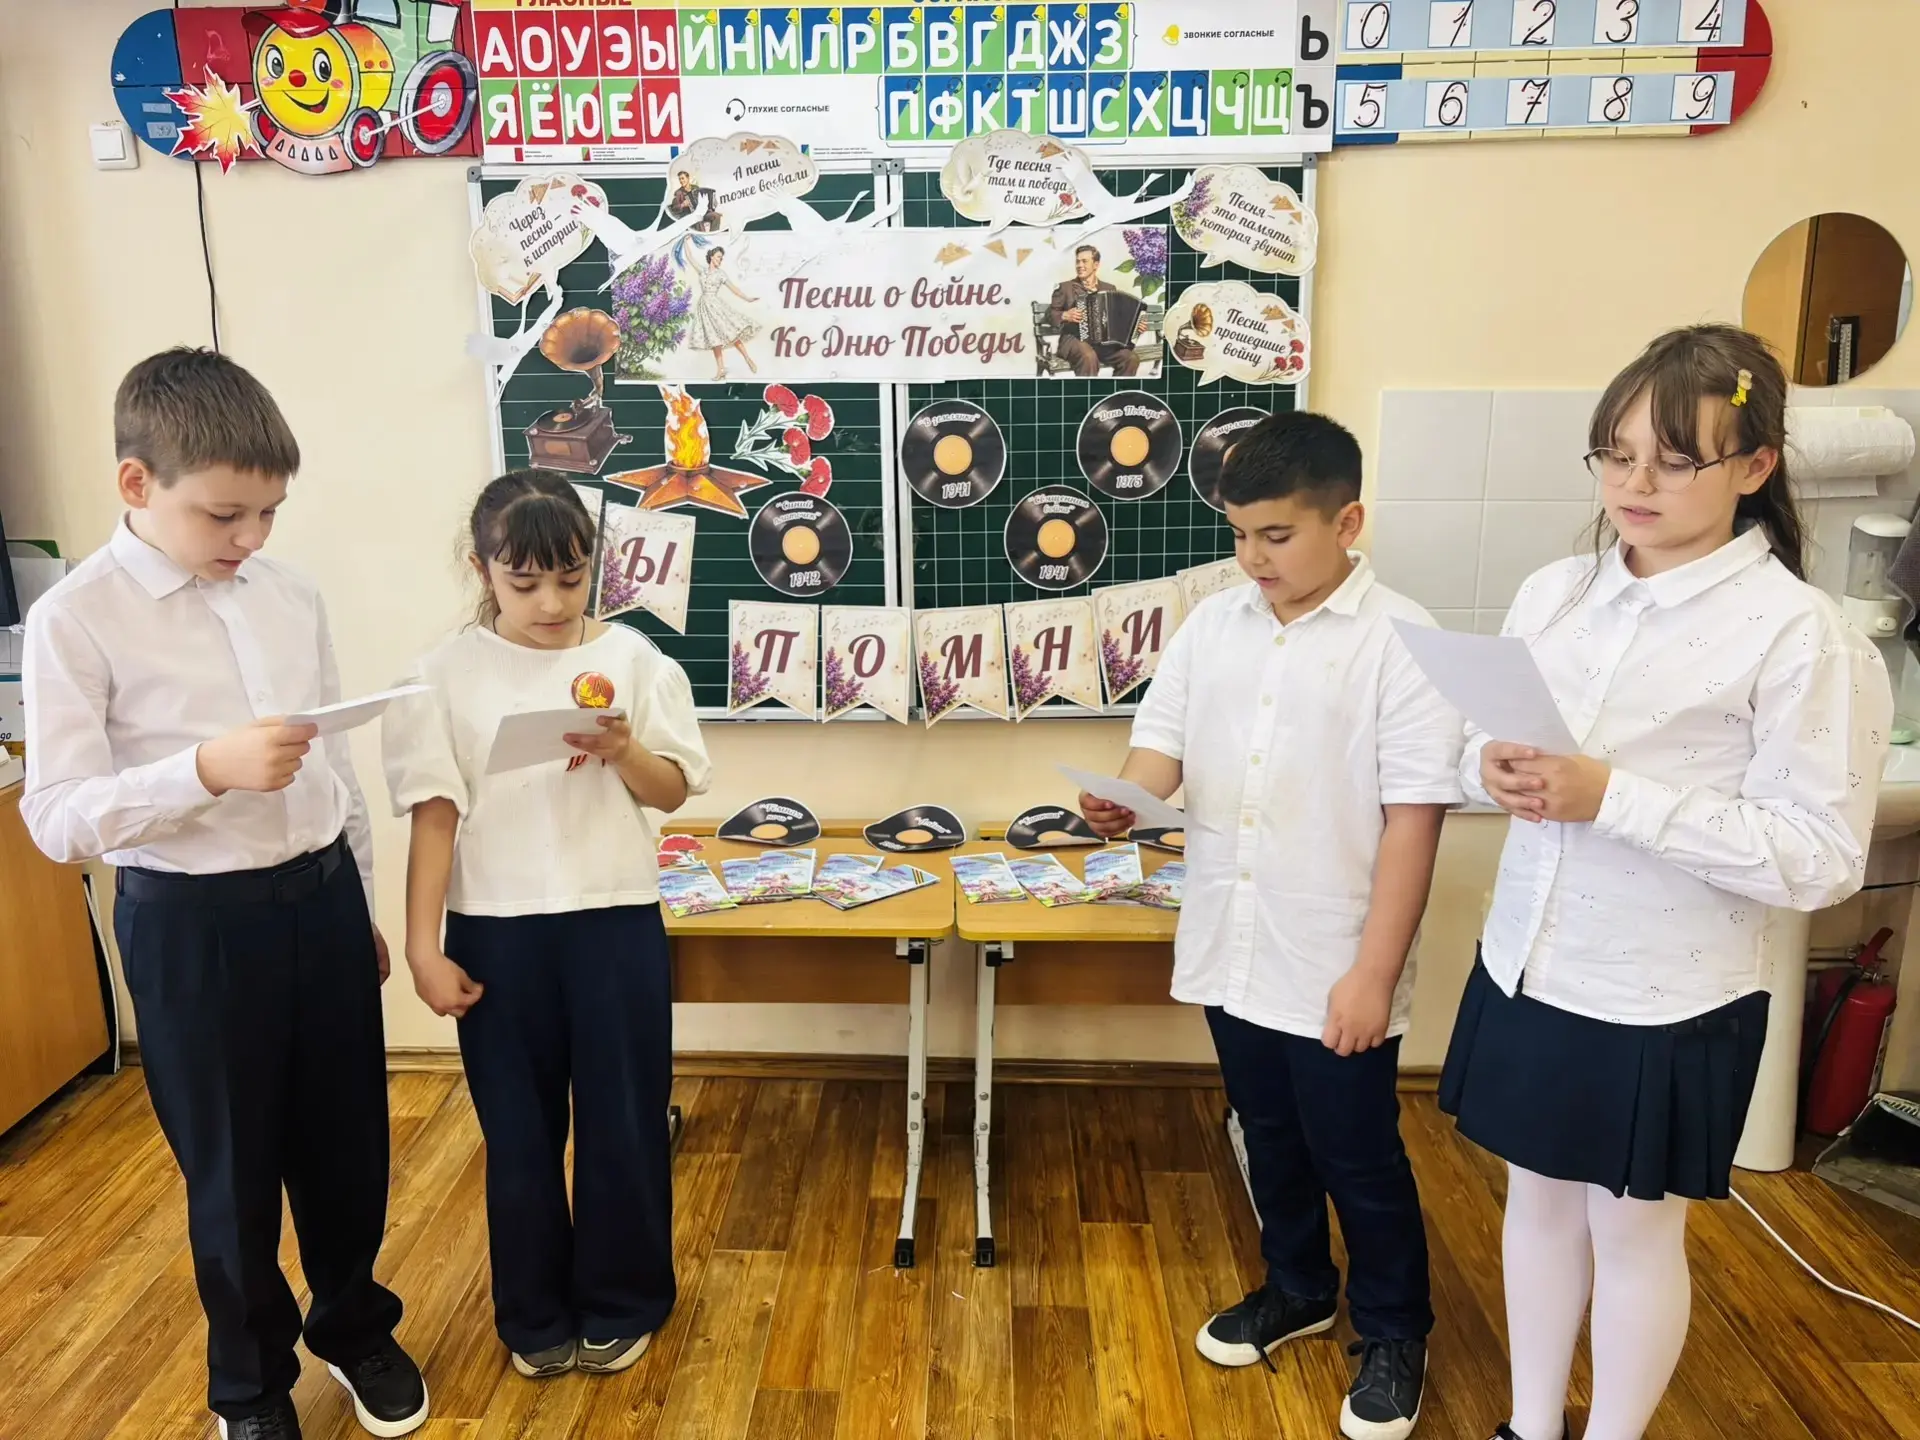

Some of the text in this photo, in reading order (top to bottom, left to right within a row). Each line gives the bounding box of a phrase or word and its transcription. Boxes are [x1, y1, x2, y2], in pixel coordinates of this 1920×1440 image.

[1183, 29, 1275, 39] ЗВОНКИЕ СОГЛАСНЫЕ
[1300, 14, 1330, 61] Ь
[1360, 0, 1721, 50] 0 1 2 3 4
[481, 14, 1123, 72] А О У Э Ы Й Н М Л Р Б В Г Д Ж З
[487, 82, 680, 138] Я Ё Ю Е И
[748, 105, 830, 114] ГЛУХИЕ СОГЛАСНЫЕ
[890, 84, 1290, 135] П Ф К Т Ш С Х Ц Ч Щ
[1296, 83, 1329, 129] Ъ
[1353, 74, 1717, 129] 5 6 7 8 9
[733, 158, 782, 181] А песни
[987, 154, 1012, 173] Где
[1014, 160, 1053, 173] песня
[719, 184, 756, 205] тоже
[987, 175, 1068, 195] там и победа
[1003, 190, 1046, 206] ближе
[1228, 191, 1268, 219] Песня
[508, 206, 547, 233] Через
[1211, 206, 1294, 247] это память,
[520, 219, 554, 252] песню
[523, 219, 579, 268] к истории
[1199, 217, 1297, 265] которая звучит
[778, 275, 1012, 309] Песни о войне.
[1226, 308, 1269, 336] Песни,
[770, 323, 1026, 364] Ко Дню Победы
[1214, 326, 1287, 354] прошедшие
[1223, 342, 1262, 368] войну
[941, 480, 972, 500] 1941
[1115, 474, 1144, 489] 1975
[789, 569, 822, 589] 1942
[1038, 564, 1070, 581] 1941
